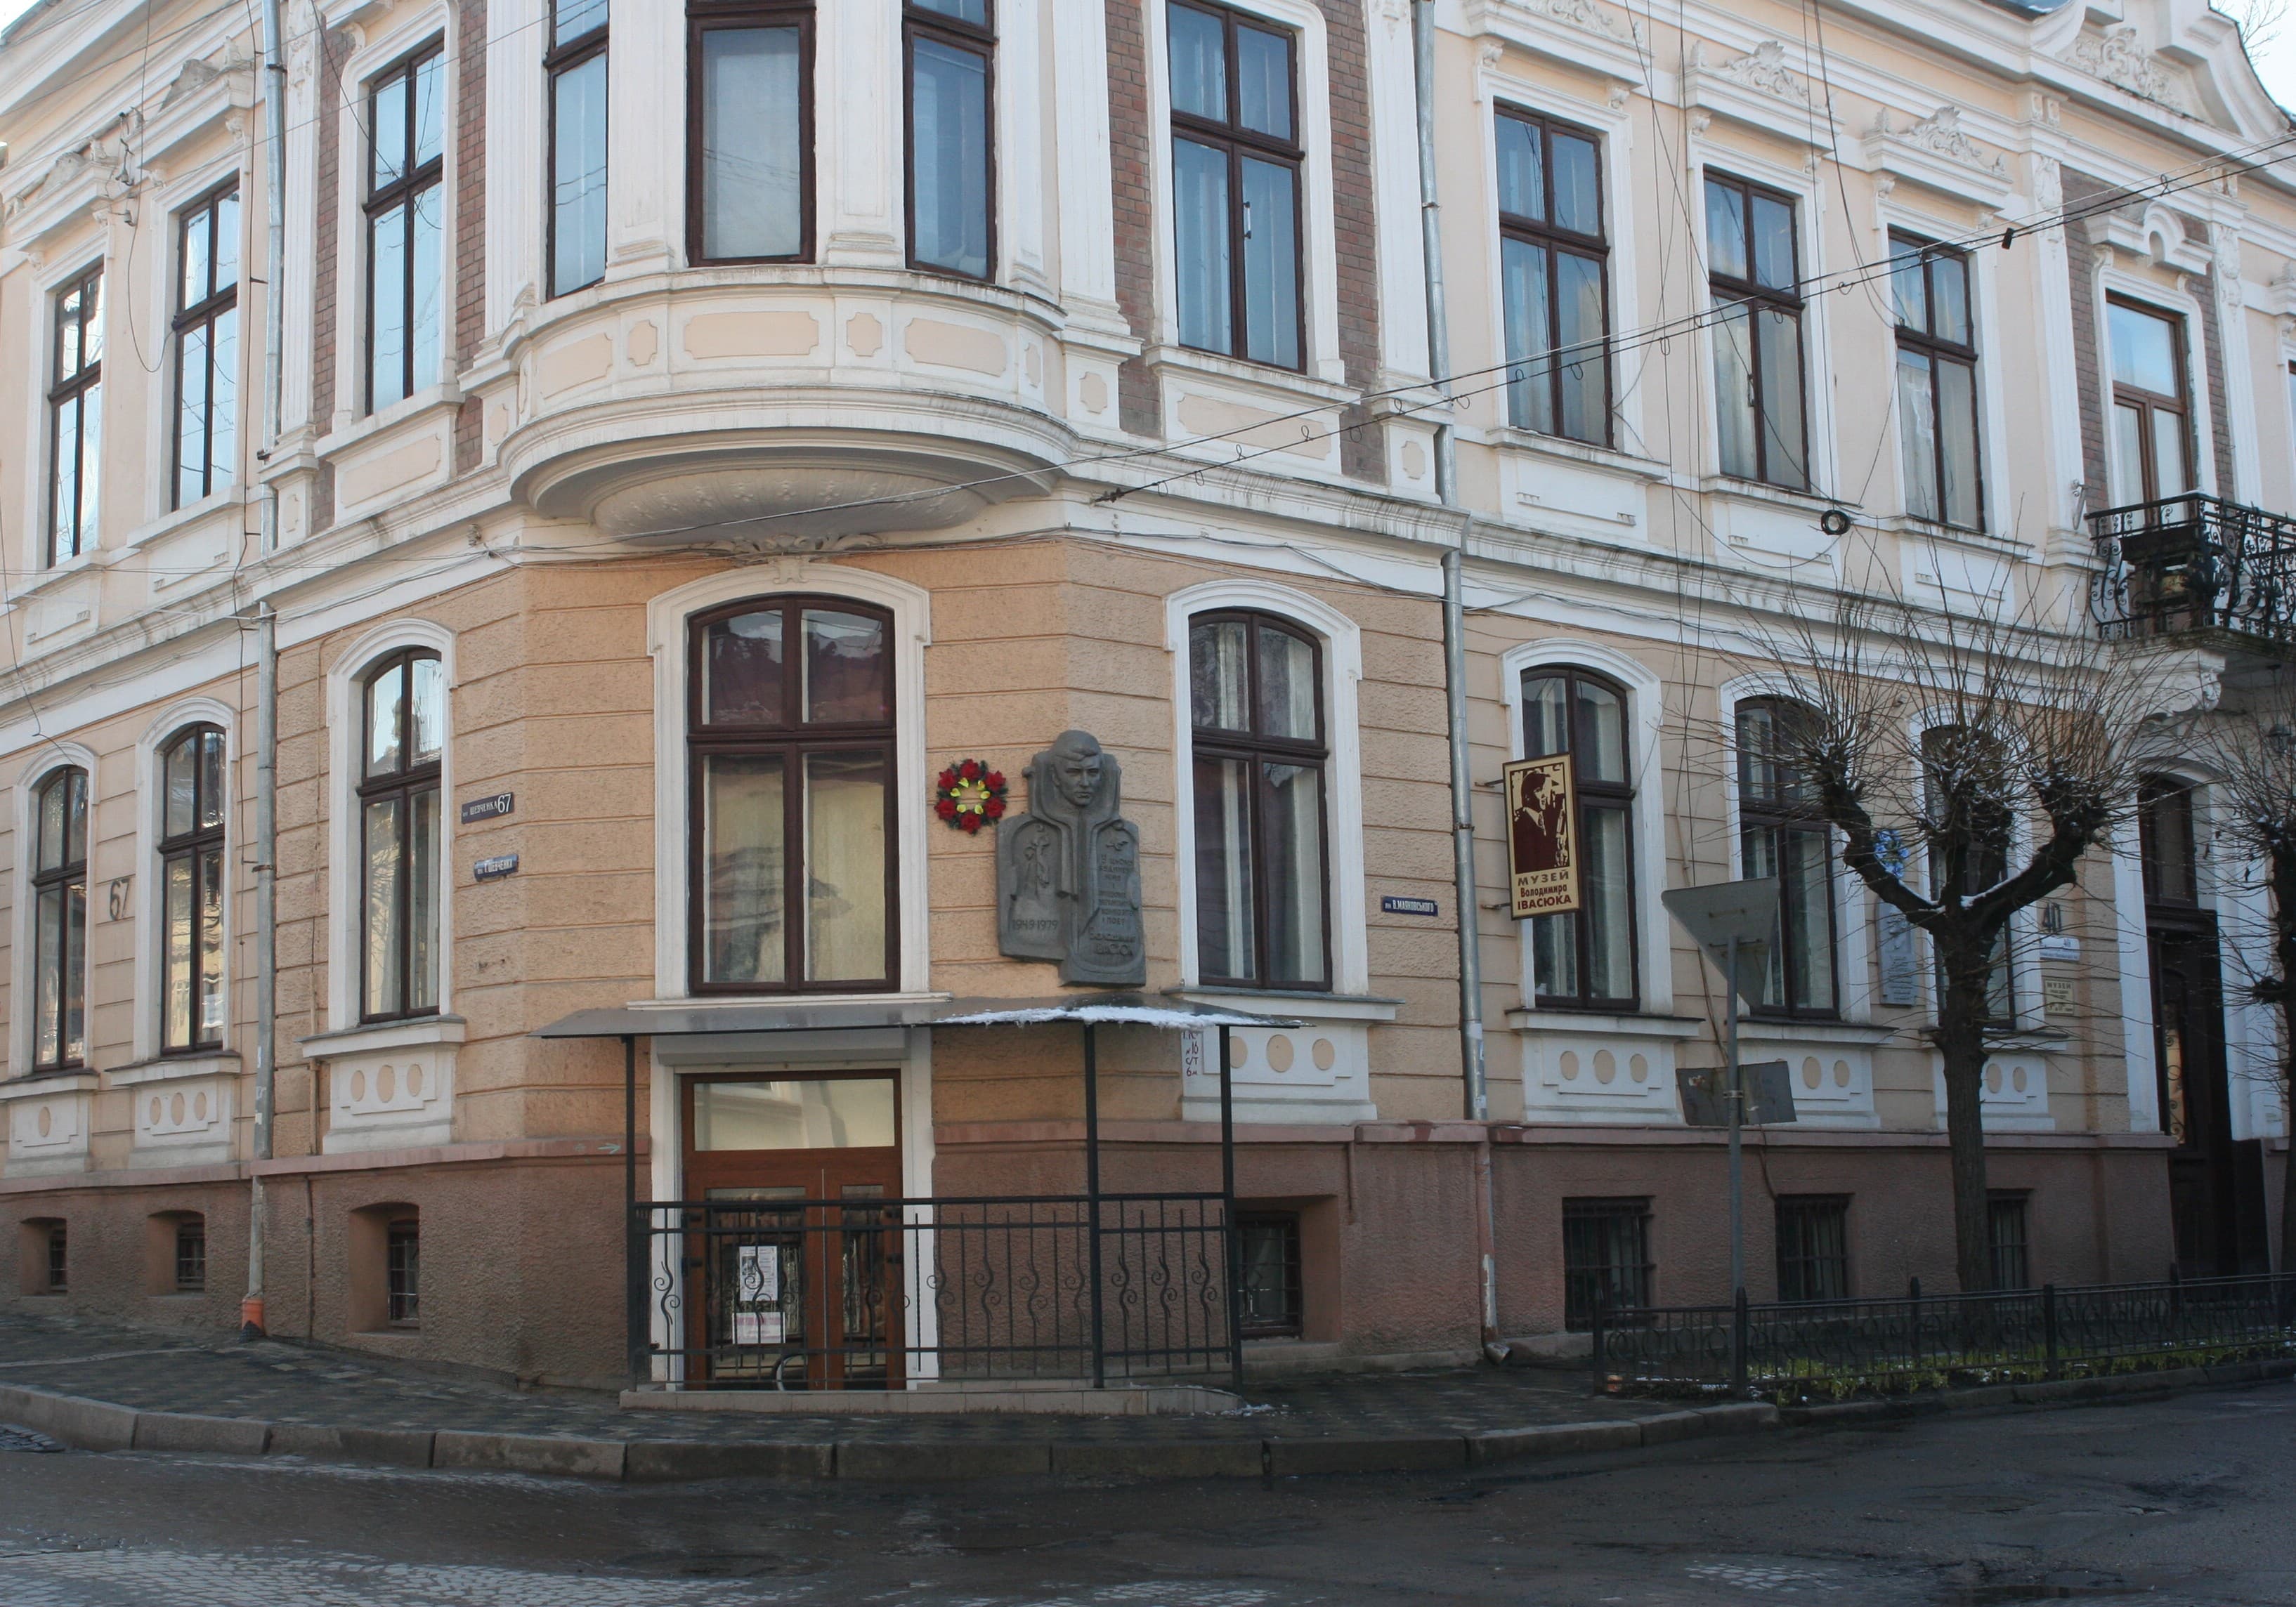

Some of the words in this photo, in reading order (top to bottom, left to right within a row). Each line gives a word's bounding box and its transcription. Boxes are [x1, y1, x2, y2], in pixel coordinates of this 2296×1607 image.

[497, 794, 511, 813] 67
[1518, 869, 1570, 886] МУЗЕЙ
[1520, 884, 1567, 897] Володимира
[110, 879, 130, 921] 67
[1518, 895, 1572, 910] ІВАСЮКА
